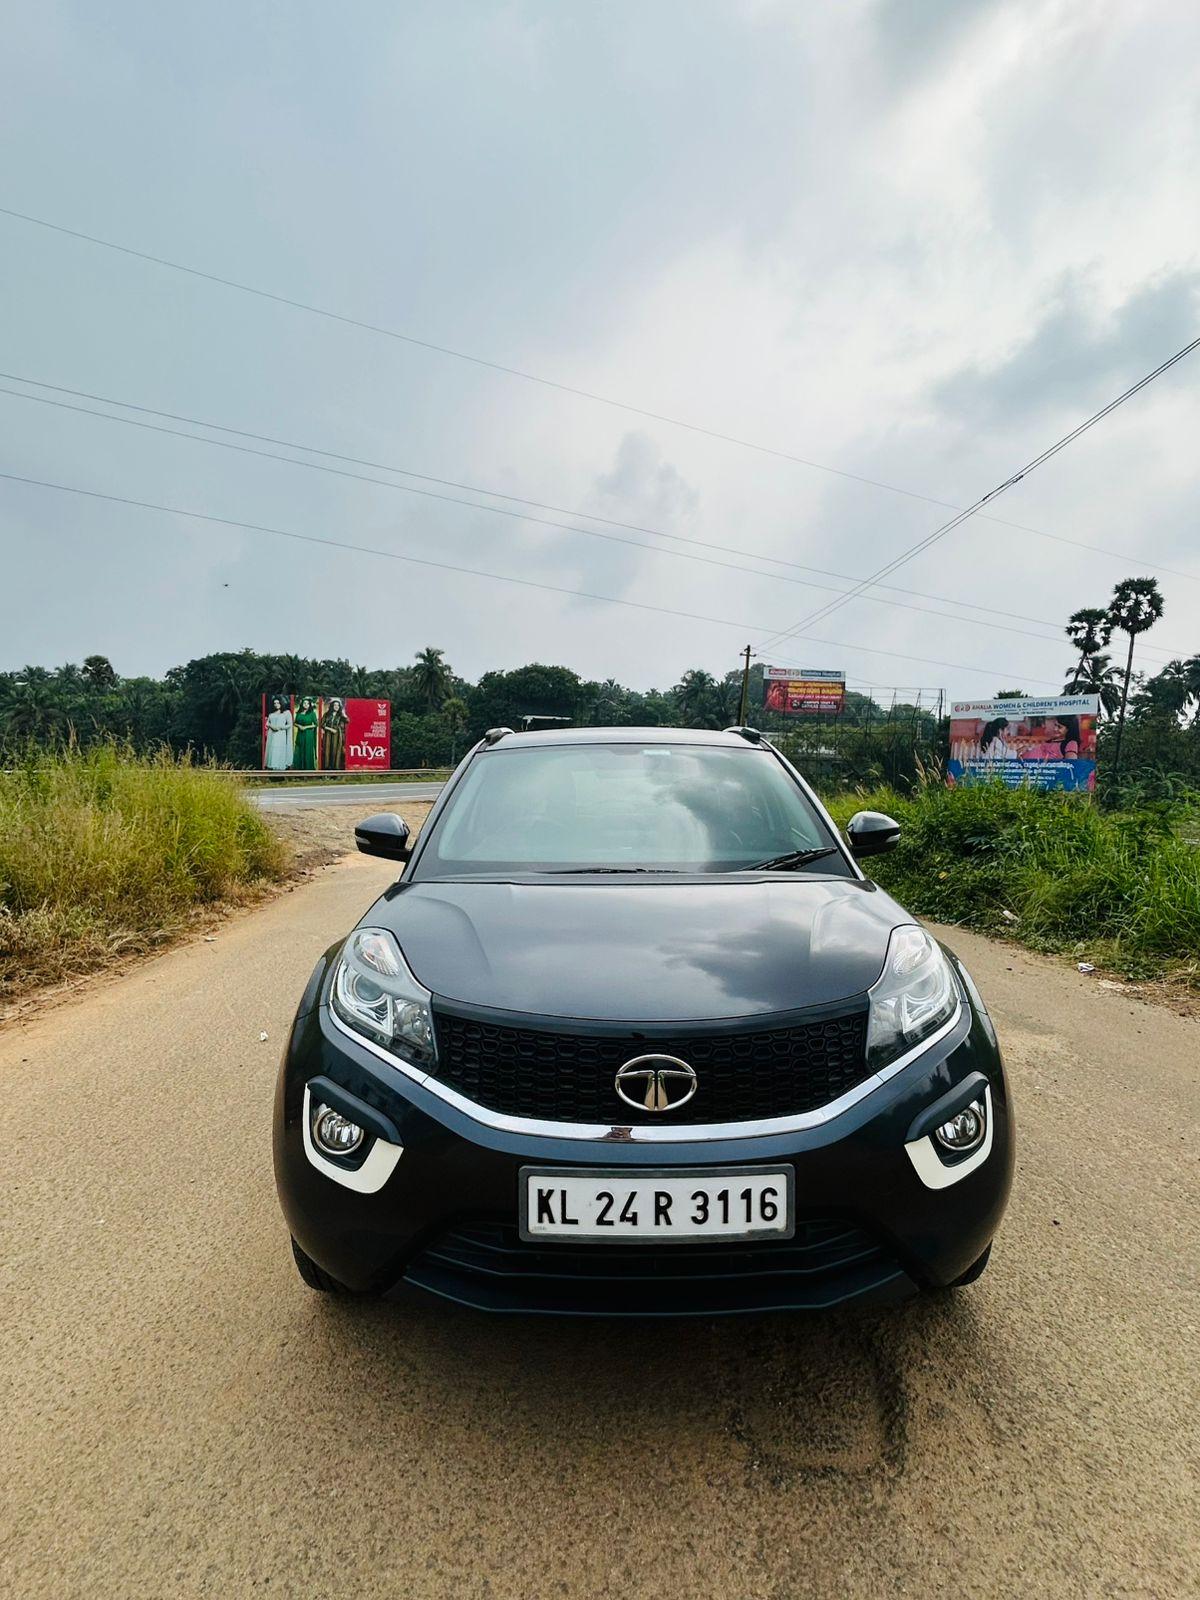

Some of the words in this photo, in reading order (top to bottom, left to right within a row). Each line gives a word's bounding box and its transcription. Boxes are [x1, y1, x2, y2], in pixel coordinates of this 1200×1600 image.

[1022, 700, 1058, 708] CHILDREN'S
[349, 741, 387, 760] niya
[537, 1188, 579, 1225] KL
[595, 1191, 638, 1226] 24
[654, 1191, 673, 1226] R
[690, 1187, 778, 1225] 3116
